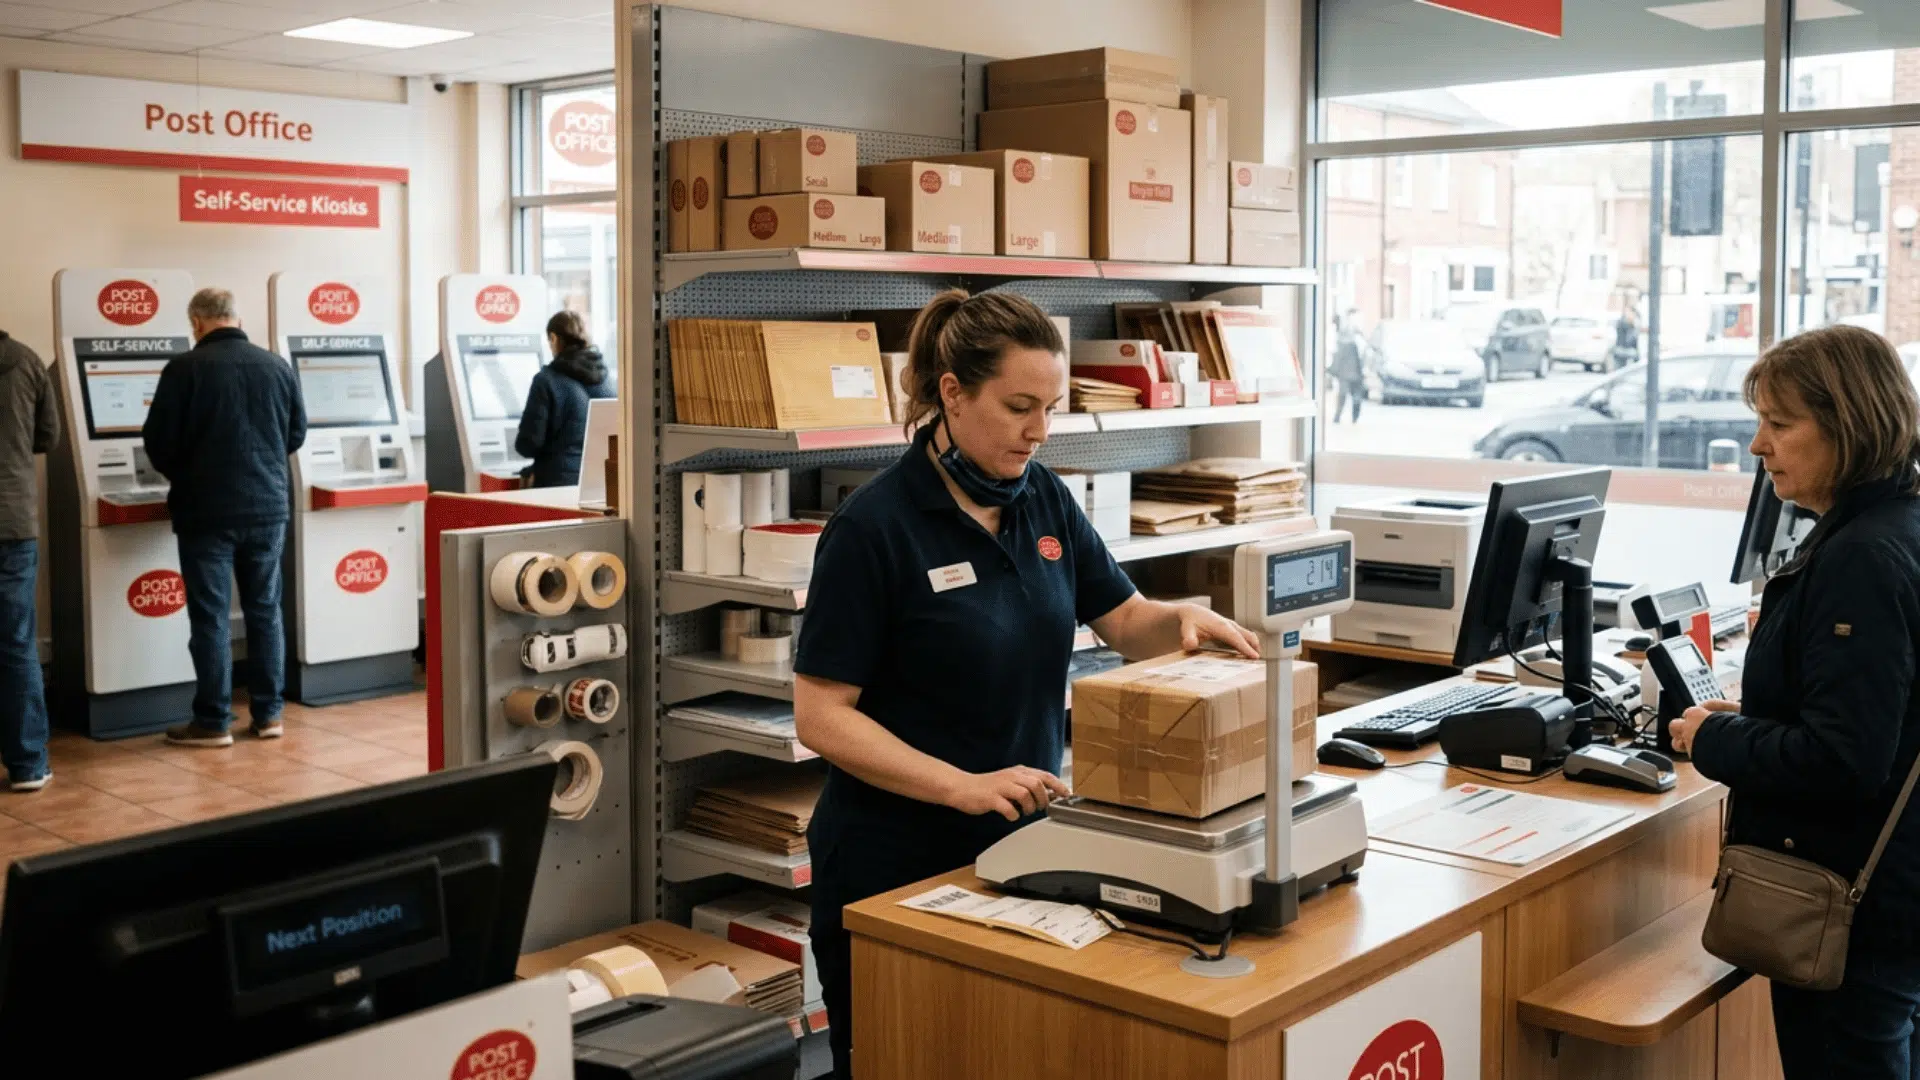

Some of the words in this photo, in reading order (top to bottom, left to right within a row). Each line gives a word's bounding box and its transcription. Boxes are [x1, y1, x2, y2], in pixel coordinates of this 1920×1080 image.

[145, 103, 214, 135] Post
[225, 109, 312, 142] Office
[565, 111, 611, 135] POST
[194, 189, 306, 213] Self-Service
[312, 194, 368, 217] Kiosks
[1011, 233, 1039, 250] Large
[111, 289, 147, 301] POST
[103, 301, 153, 315] OFFICE
[140, 577, 179, 594] POST
[266, 924, 317, 954] Next
[321, 904, 402, 938] Position
[468, 1040, 520, 1073] POST
